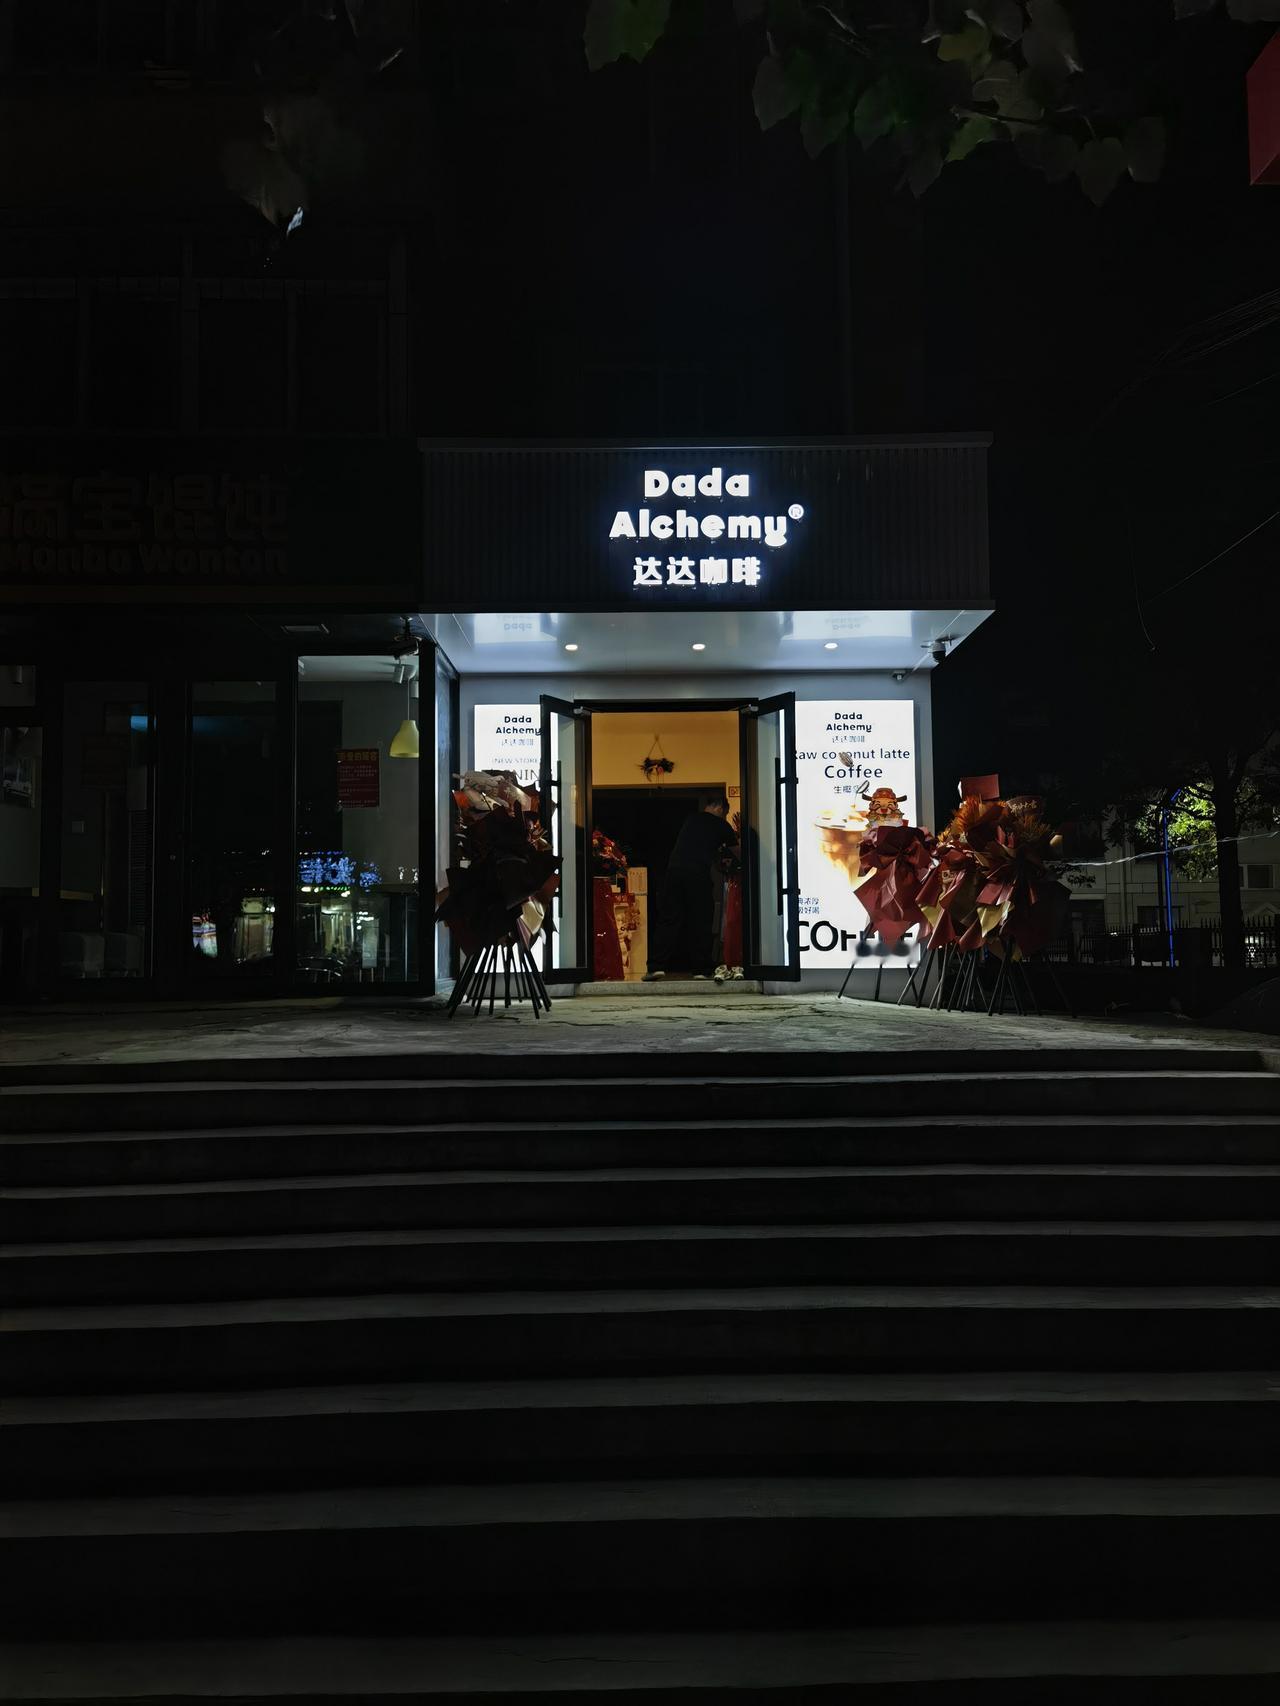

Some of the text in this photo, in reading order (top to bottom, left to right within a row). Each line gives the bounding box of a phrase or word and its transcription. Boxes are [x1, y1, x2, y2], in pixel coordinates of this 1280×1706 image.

[644, 467, 750, 498] Dada
[633, 556, 761, 586] 达达咖啡
[504, 716, 532, 724] Dada
[826, 723, 872, 733] Alchemy
[880, 748, 911, 760] latte
[825, 764, 884, 779] Coffee
